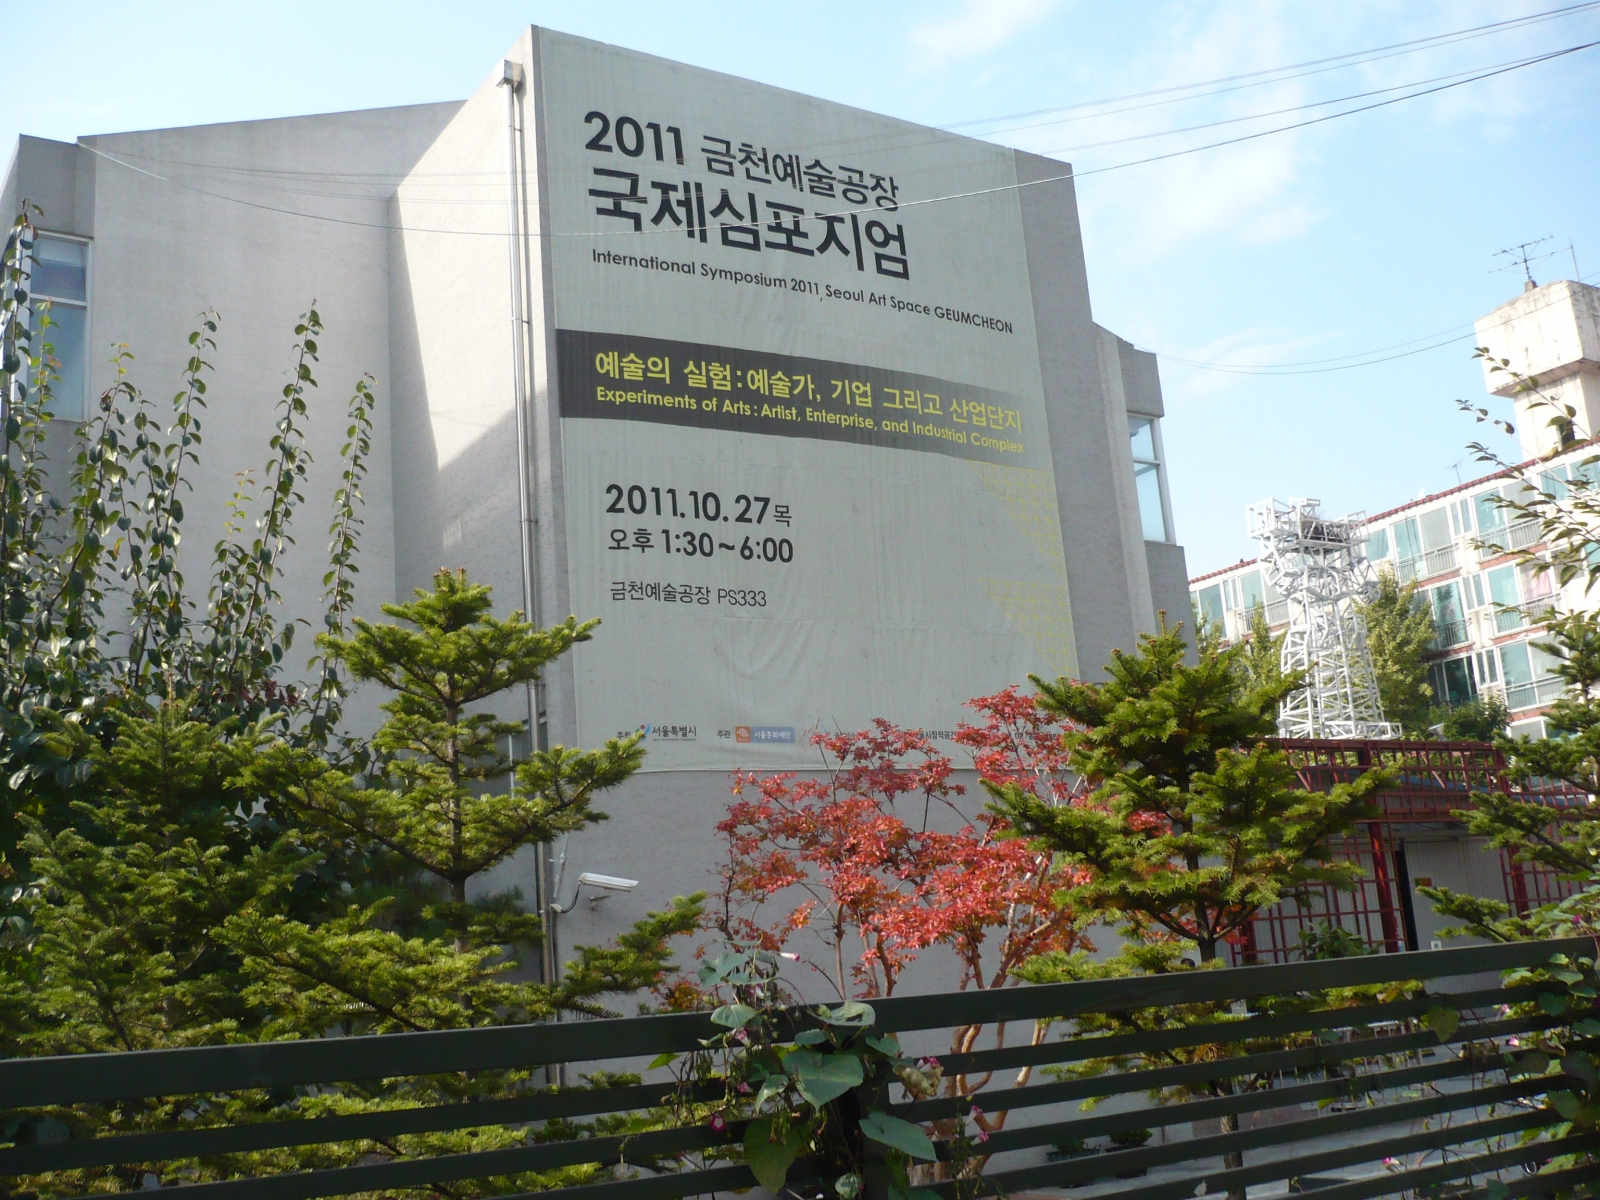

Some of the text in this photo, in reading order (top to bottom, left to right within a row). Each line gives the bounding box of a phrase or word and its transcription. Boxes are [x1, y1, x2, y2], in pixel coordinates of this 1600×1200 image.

[584, 111, 898, 212] 2011 금천예술공장
[588, 167, 909, 280] 국제심포지엄
[592, 248, 696, 275] International
[701, 263, 787, 289] Symposium
[826, 285, 864, 303] Seoul
[868, 292, 887, 306] Art
[890, 295, 930, 317] Space
[934, 306, 1013, 334] GEUMCHEON
[596, 351, 670, 384] 예술의
[831, 379, 872, 407] 기업
[883, 388, 943, 416] 그리고
[949, 399, 1022, 434] 산업단지
[596, 386, 697, 410] Experiments
[702, 395, 718, 412] of
[806, 408, 877, 431] Enterprise,
[882, 418, 908, 433] and
[913, 421, 967, 444] Industrial
[971, 431, 1024, 454] Complex
[608, 528, 654, 553] 오후
[610, 581, 767, 607] 금천예술공장 PS333
[652, 726, 696, 737] 서울특별시
[717, 730, 731, 738] 주관
